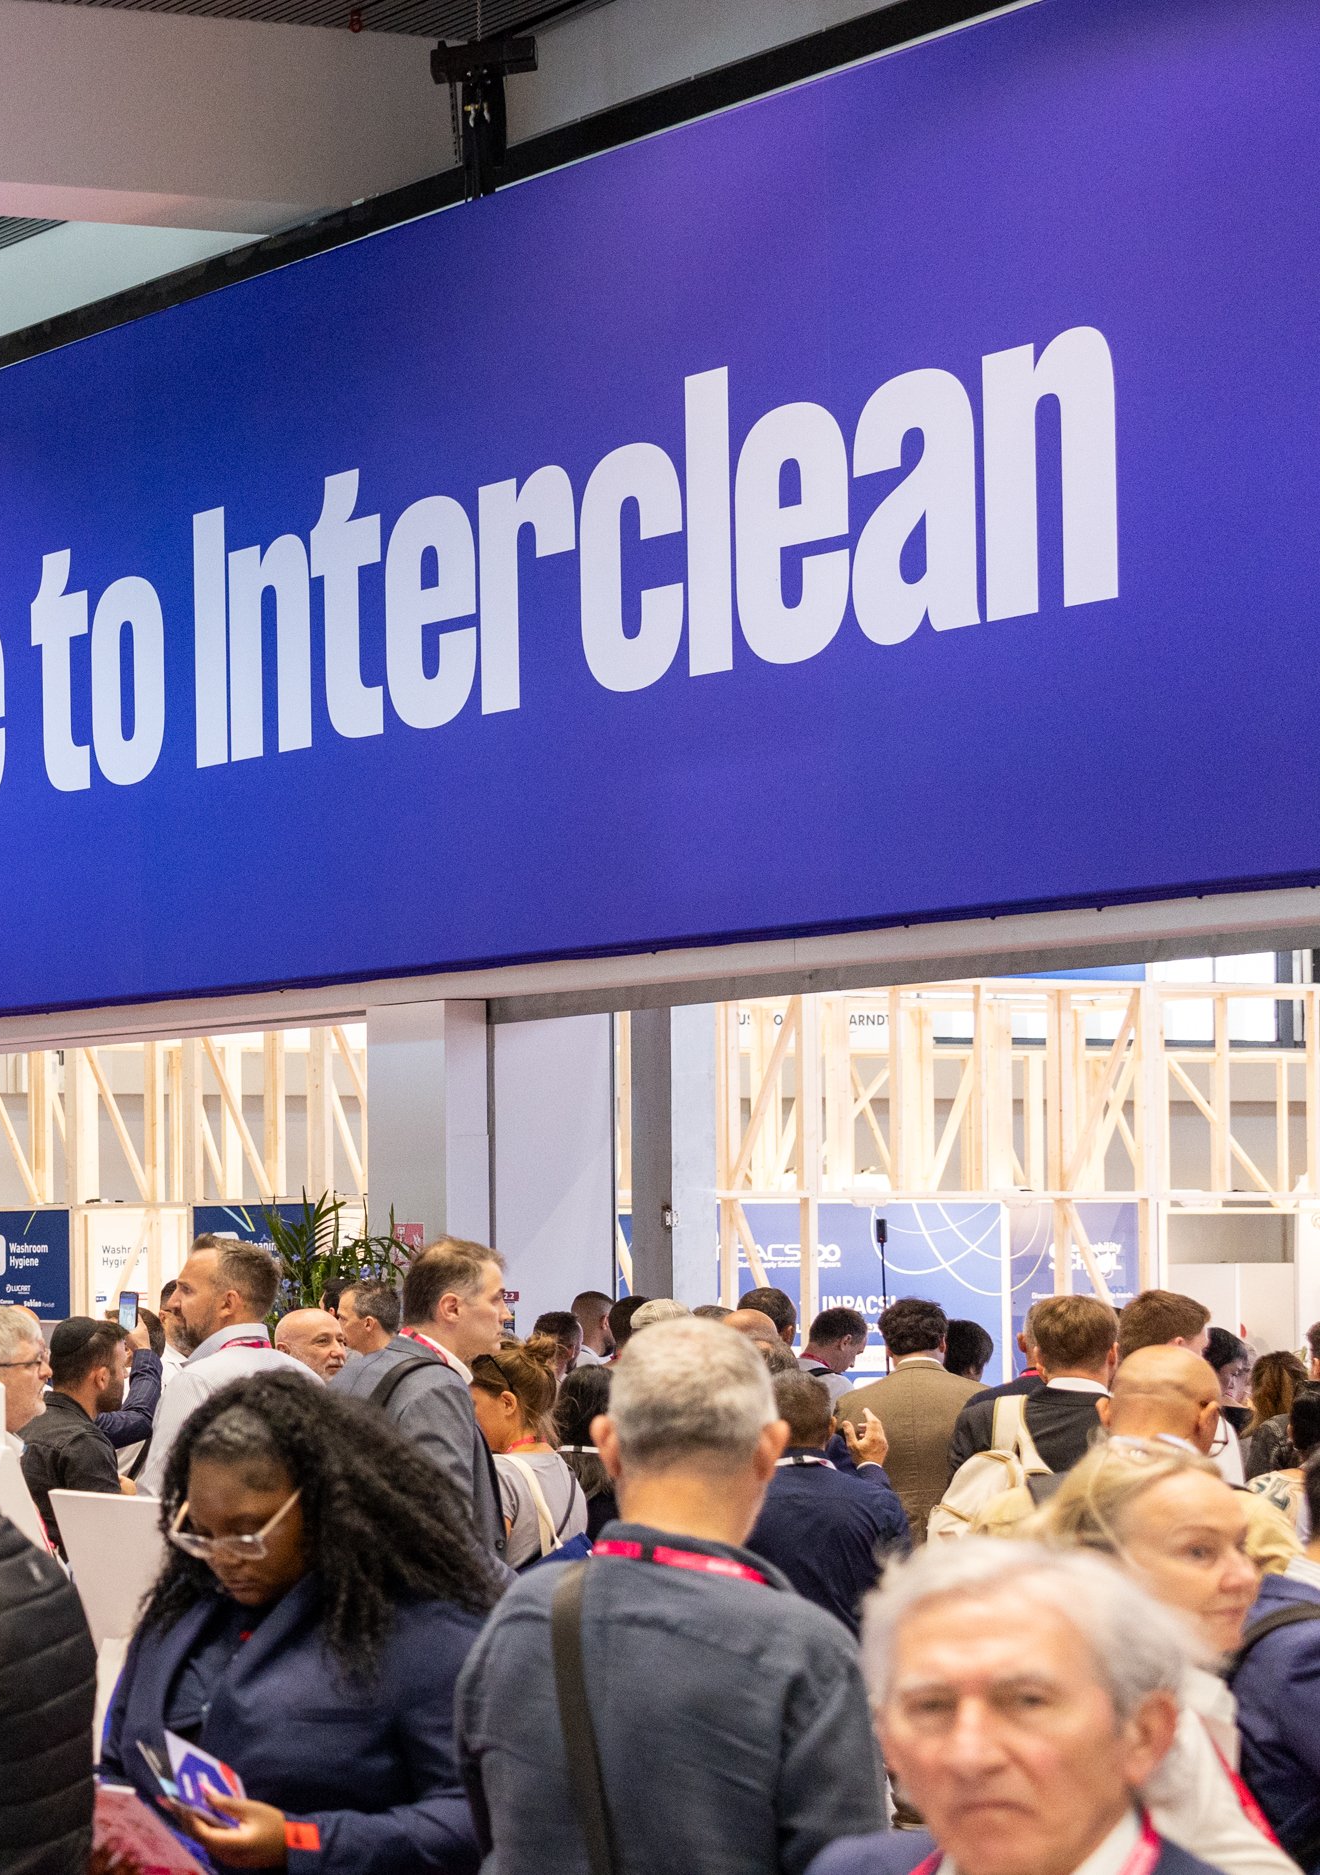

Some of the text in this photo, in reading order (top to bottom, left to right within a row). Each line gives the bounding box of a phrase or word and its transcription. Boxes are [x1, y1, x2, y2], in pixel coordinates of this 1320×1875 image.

[31, 549, 164, 791] to
[193, 326, 1119, 768] Interclean
[9, 1242, 49, 1254] Washroom
[101, 1245, 148, 1255] Washrm
[9, 1256, 39, 1269] Hygiene
[11, 1284, 31, 1292] LUCART
